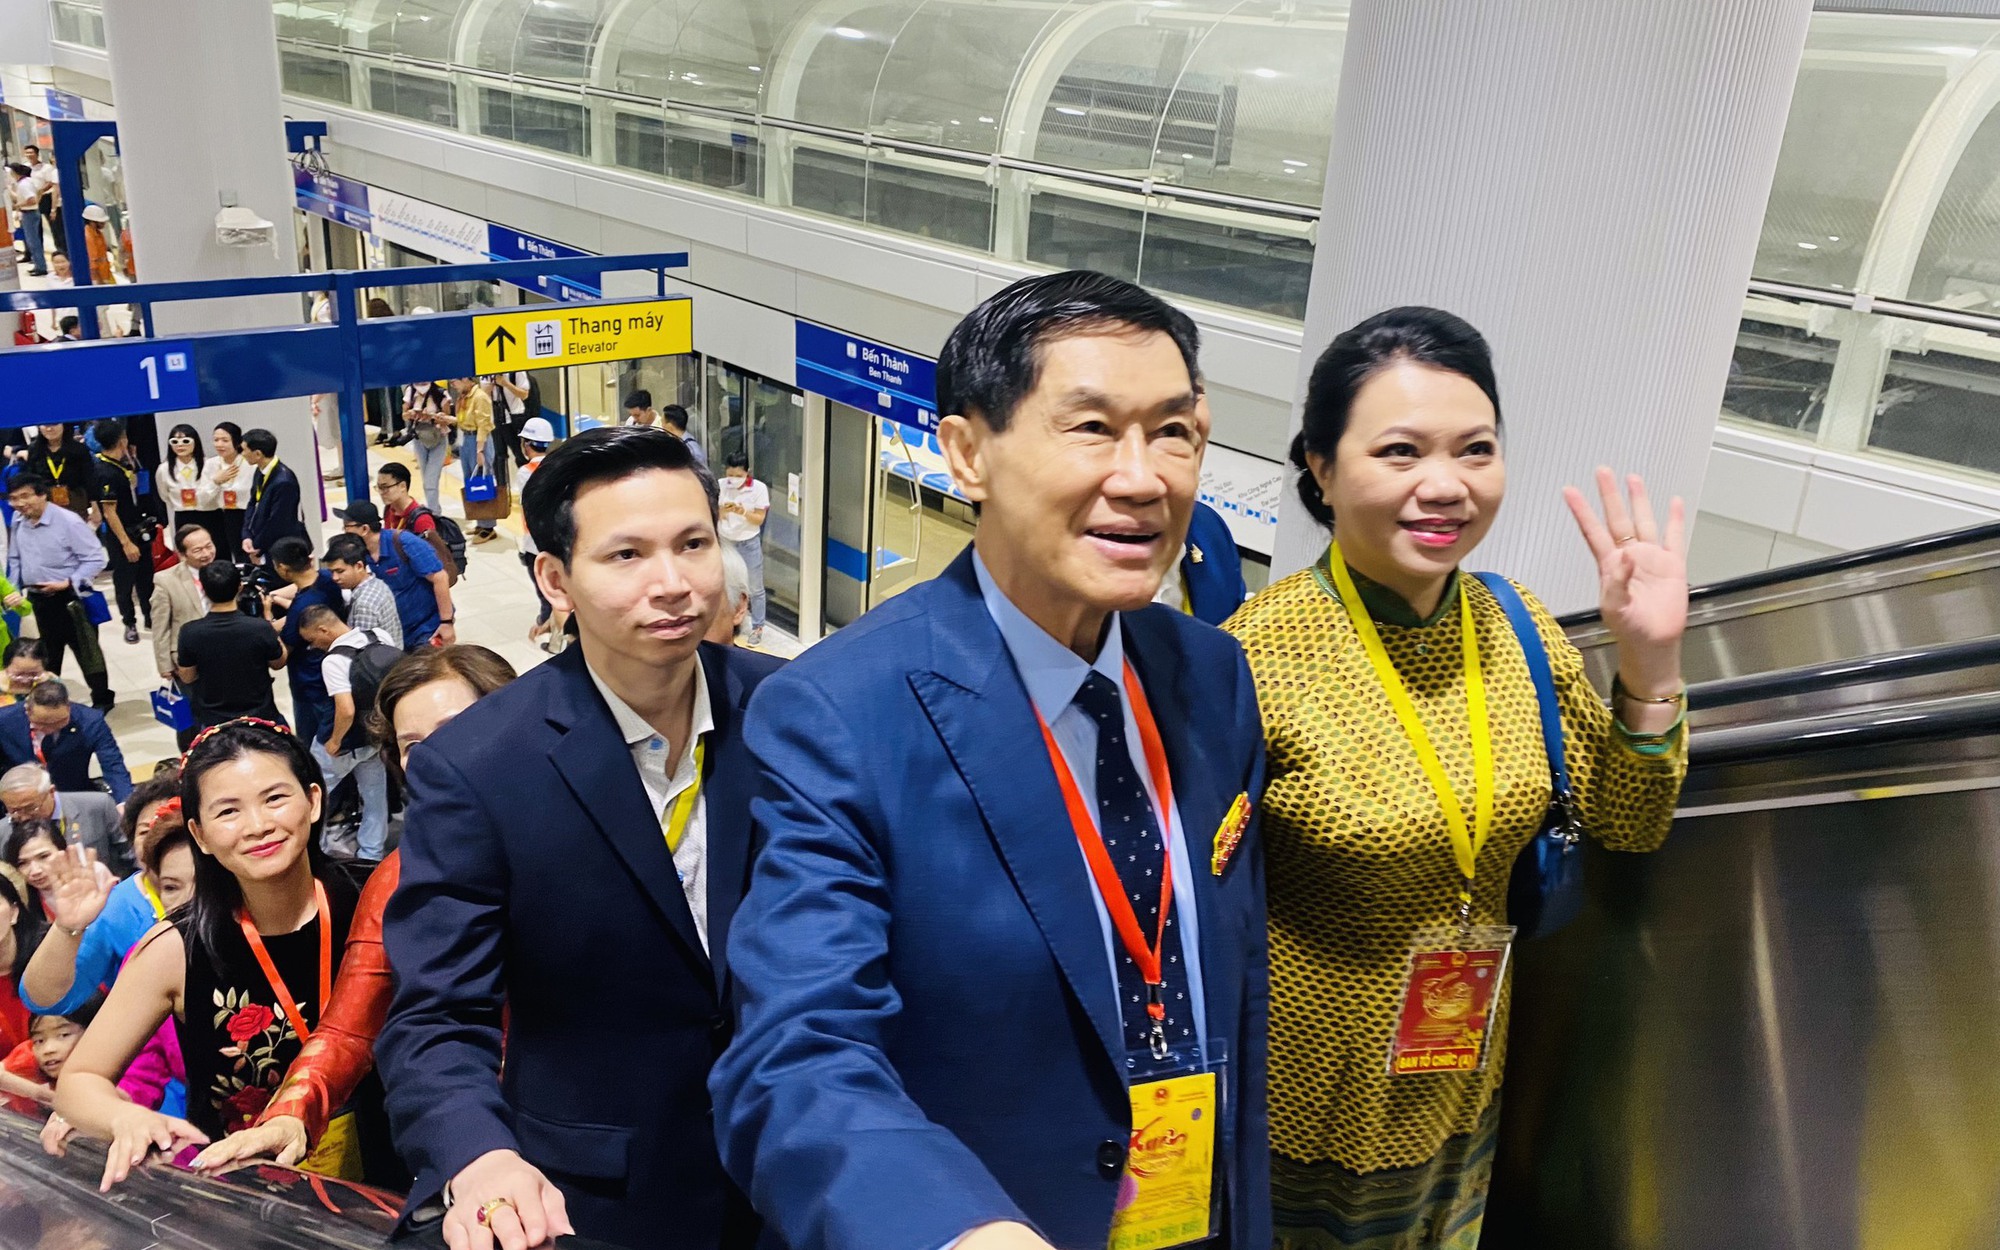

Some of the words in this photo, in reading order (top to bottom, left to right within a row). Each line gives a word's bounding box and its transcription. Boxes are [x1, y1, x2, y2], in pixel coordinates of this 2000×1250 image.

[568, 317, 622, 336] Thang
[628, 311, 664, 331] máy
[568, 341, 618, 355] Elevator
[862, 346, 880, 365] Bến
[881, 352, 910, 374] Thành
[140, 356, 160, 400] 1
[868, 366, 882, 379] Ben
[882, 370, 903, 386] Thanh
